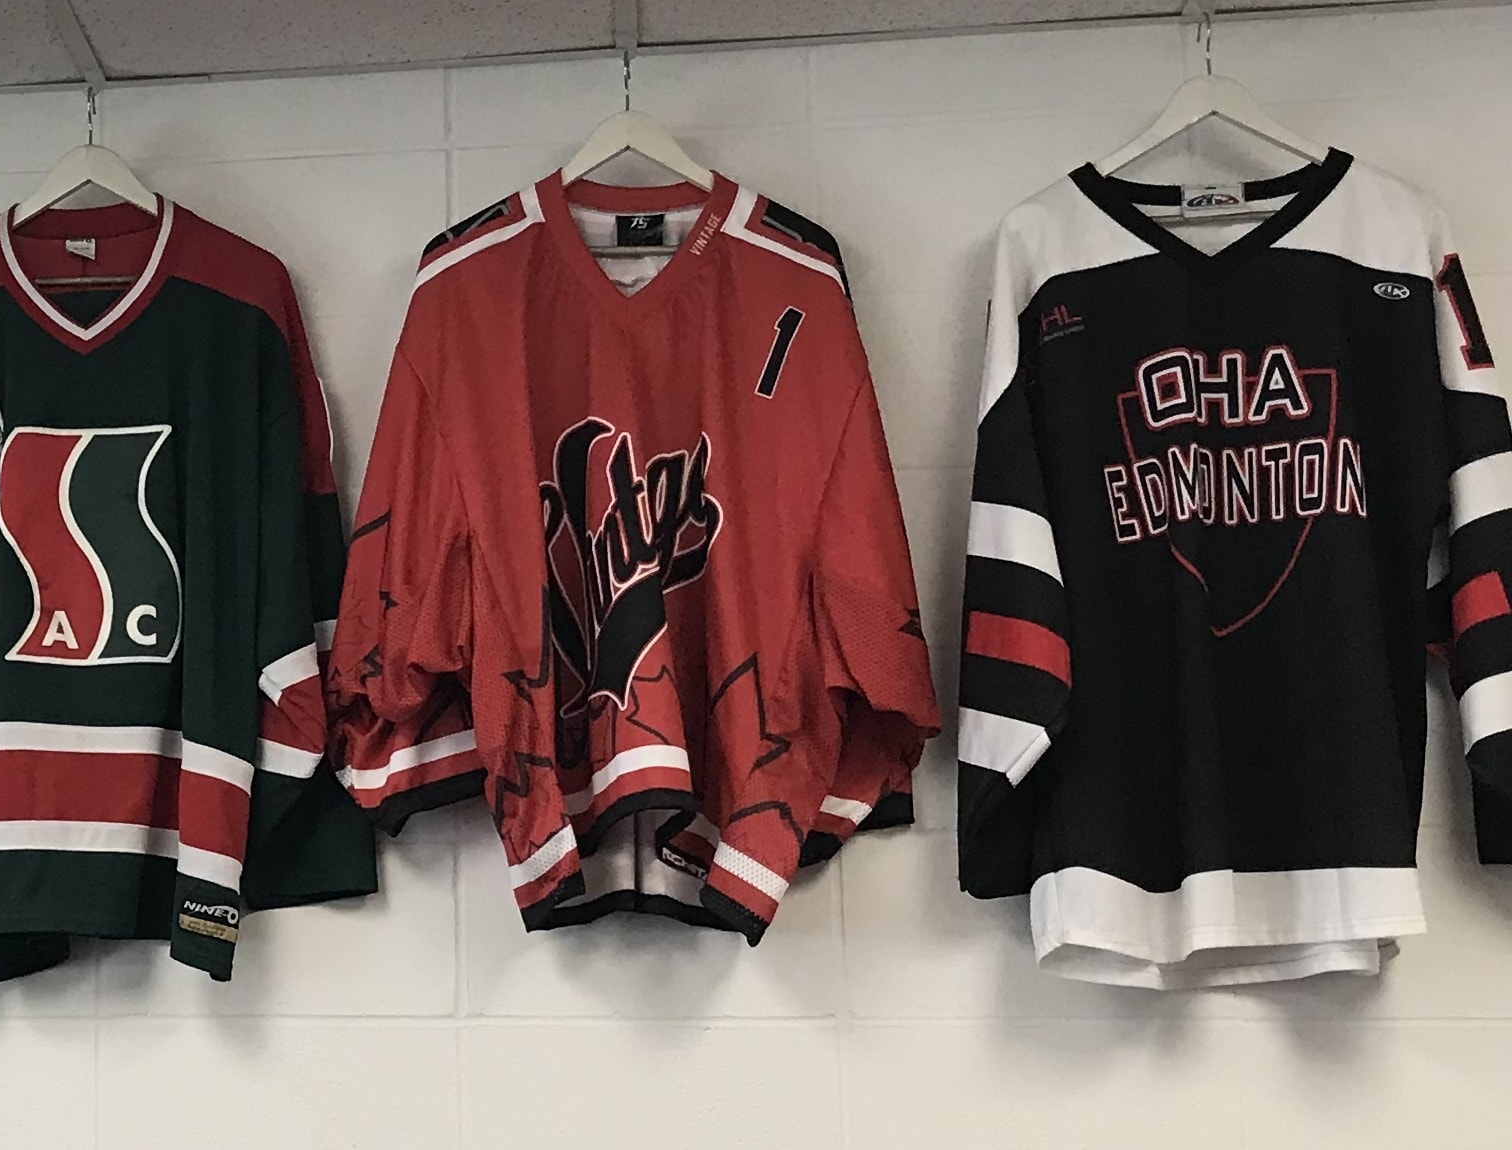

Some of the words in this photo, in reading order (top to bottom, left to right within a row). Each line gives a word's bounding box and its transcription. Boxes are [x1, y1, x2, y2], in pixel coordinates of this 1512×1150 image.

[689, 213, 722, 256] VINTAGE
[754, 306, 807, 400] 1
[1434, 253, 1495, 370] 1
[1138, 347, 1312, 431] OHA
